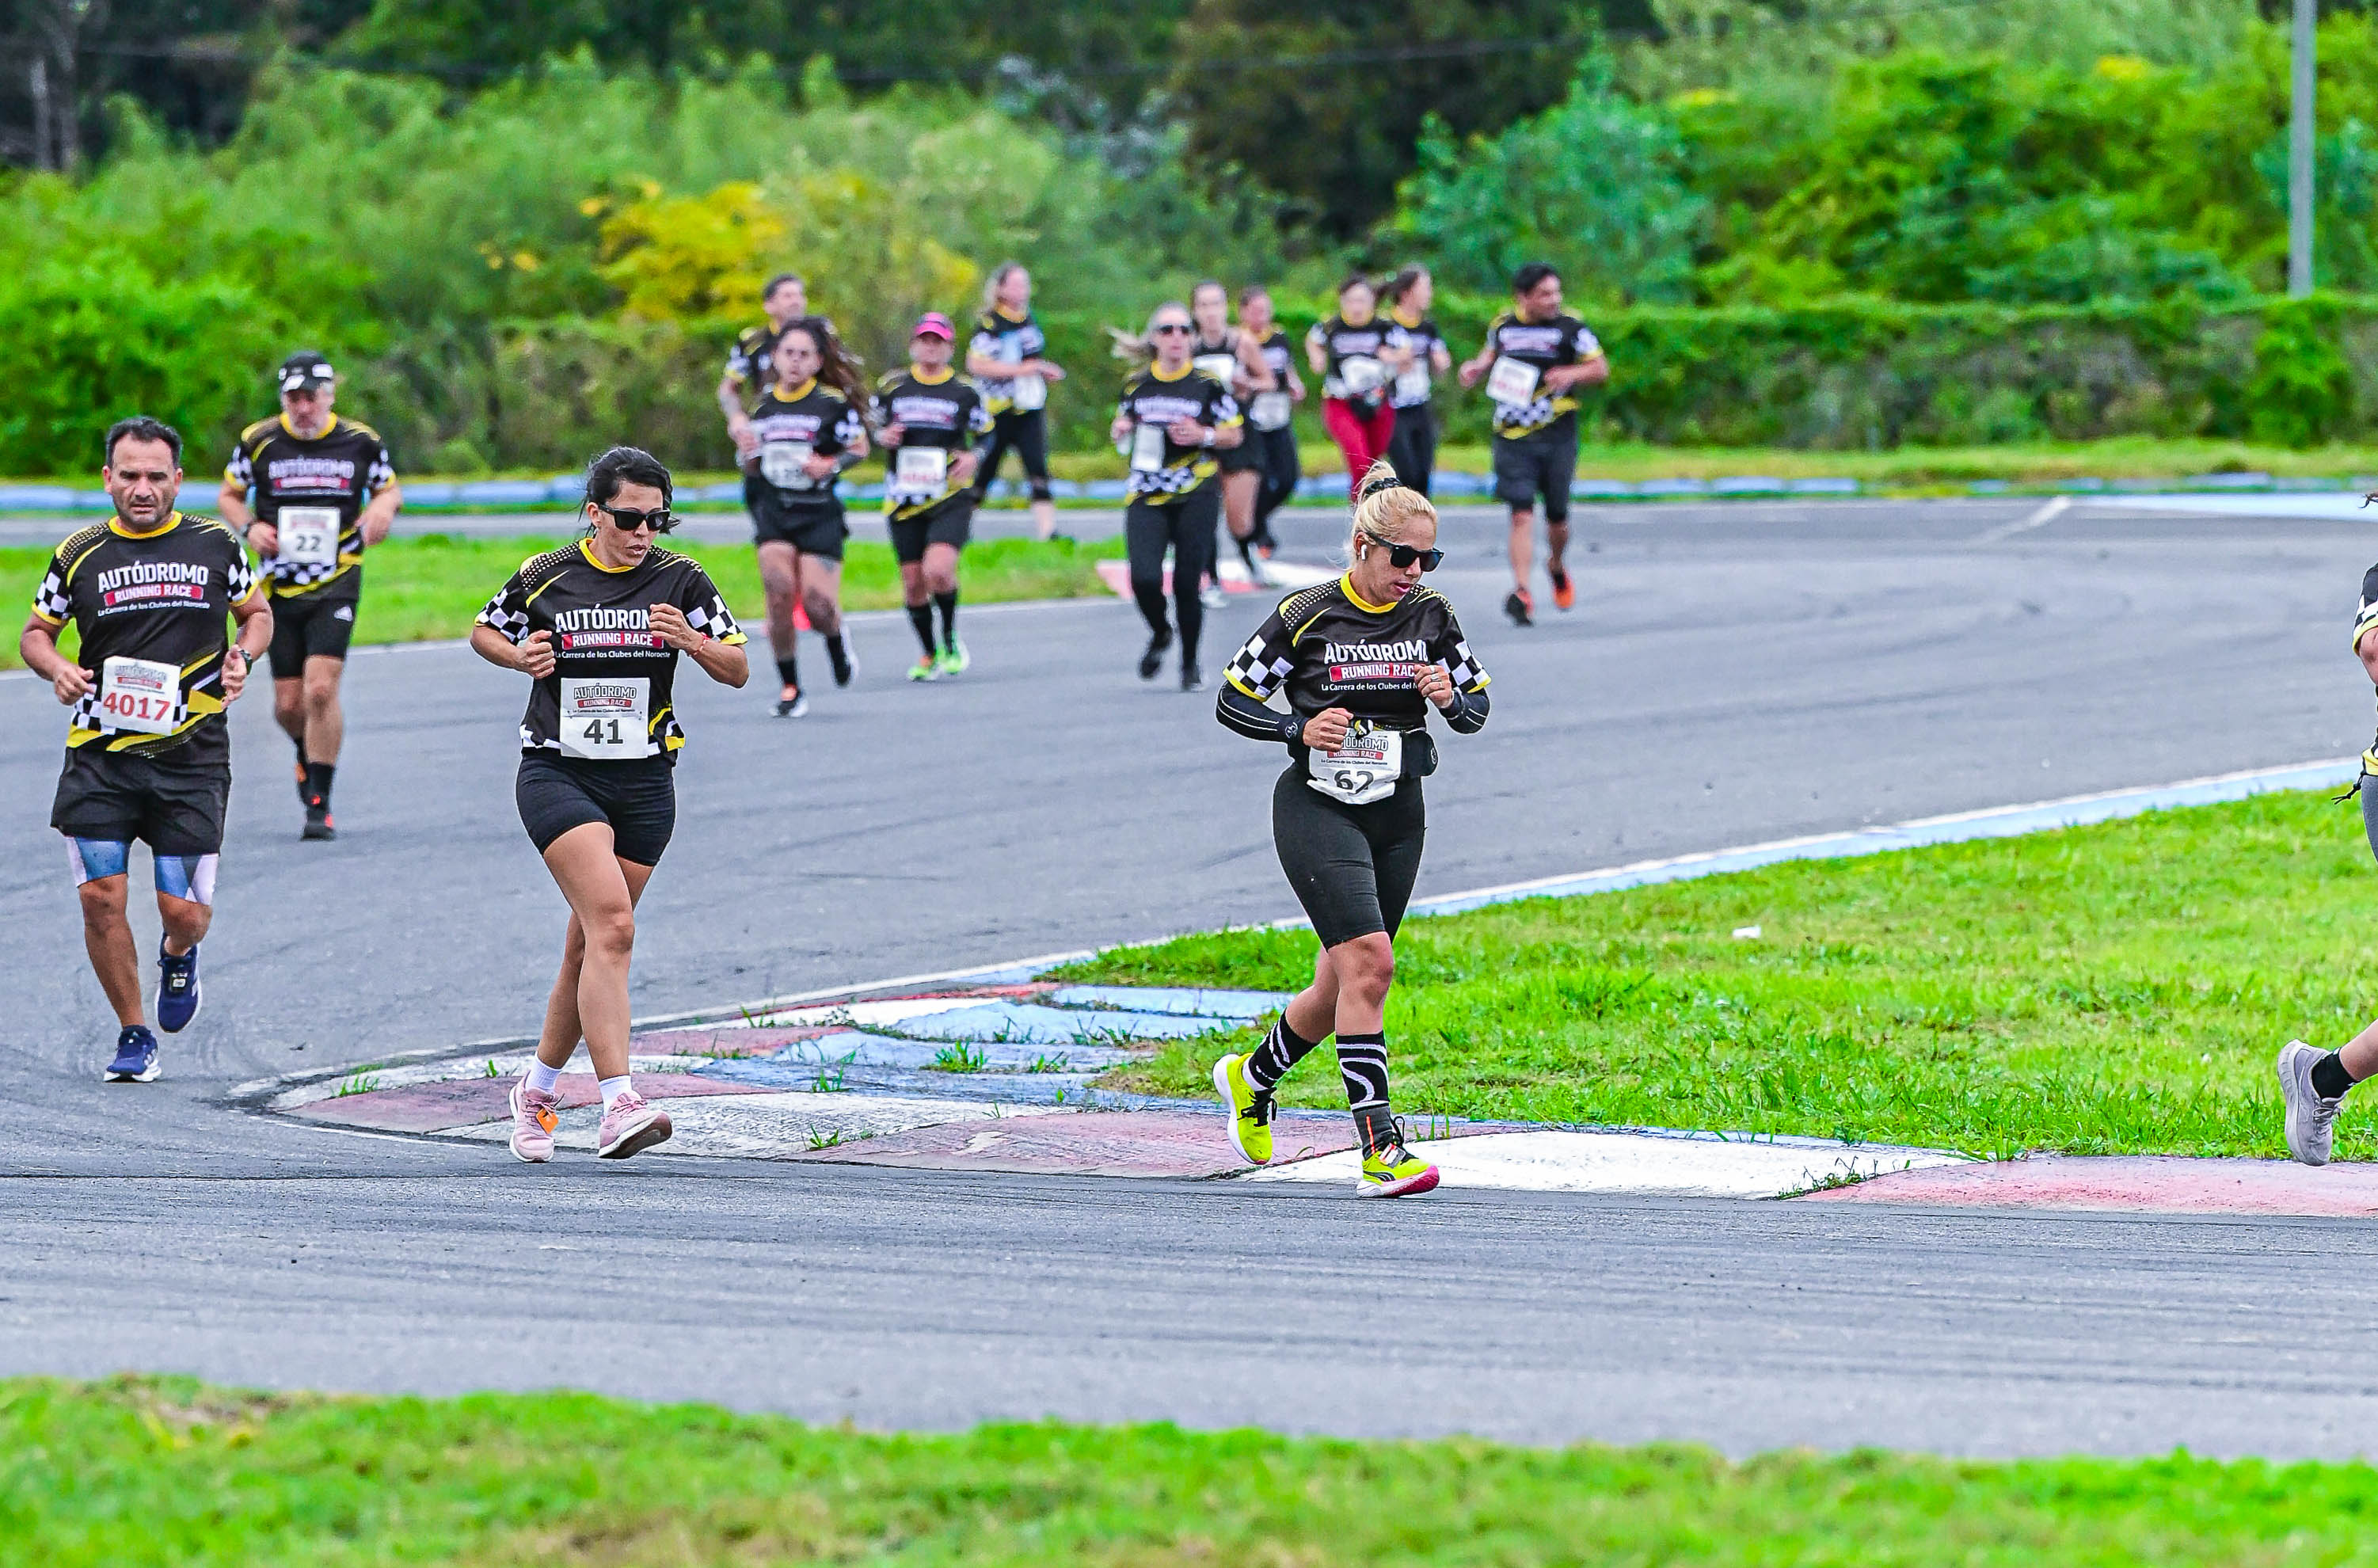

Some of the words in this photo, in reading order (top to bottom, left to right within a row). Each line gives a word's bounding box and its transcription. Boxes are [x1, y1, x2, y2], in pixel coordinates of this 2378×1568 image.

[295, 535, 322, 552] 22
[97, 559, 209, 593] AUTÓDROMO
[114, 584, 162, 603] RUNNING
[163, 584, 192, 598] RACE
[554, 603, 650, 634] AUTÓDRO
[572, 633, 621, 648] RUNNING
[624, 633, 653, 647] RACE
[608, 649, 633, 658] Clubes
[633, 649, 645, 658] del
[1341, 664, 1390, 679] RUNNING
[1394, 664, 1415, 678] RAC
[573, 682, 637, 700] AUTÓDROMO
[1322, 683, 1329, 691] La
[1330, 683, 1355, 691] Carrera
[1356, 682, 1366, 691] de
[1367, 682, 1377, 691] los
[1378, 682, 1400, 691] Clubes
[1401, 681, 1412, 690] del
[103, 691, 171, 721] 4017
[583, 719, 623, 744] 41
[1360, 751, 1377, 759] RACE
[1334, 770, 1375, 795] 62
